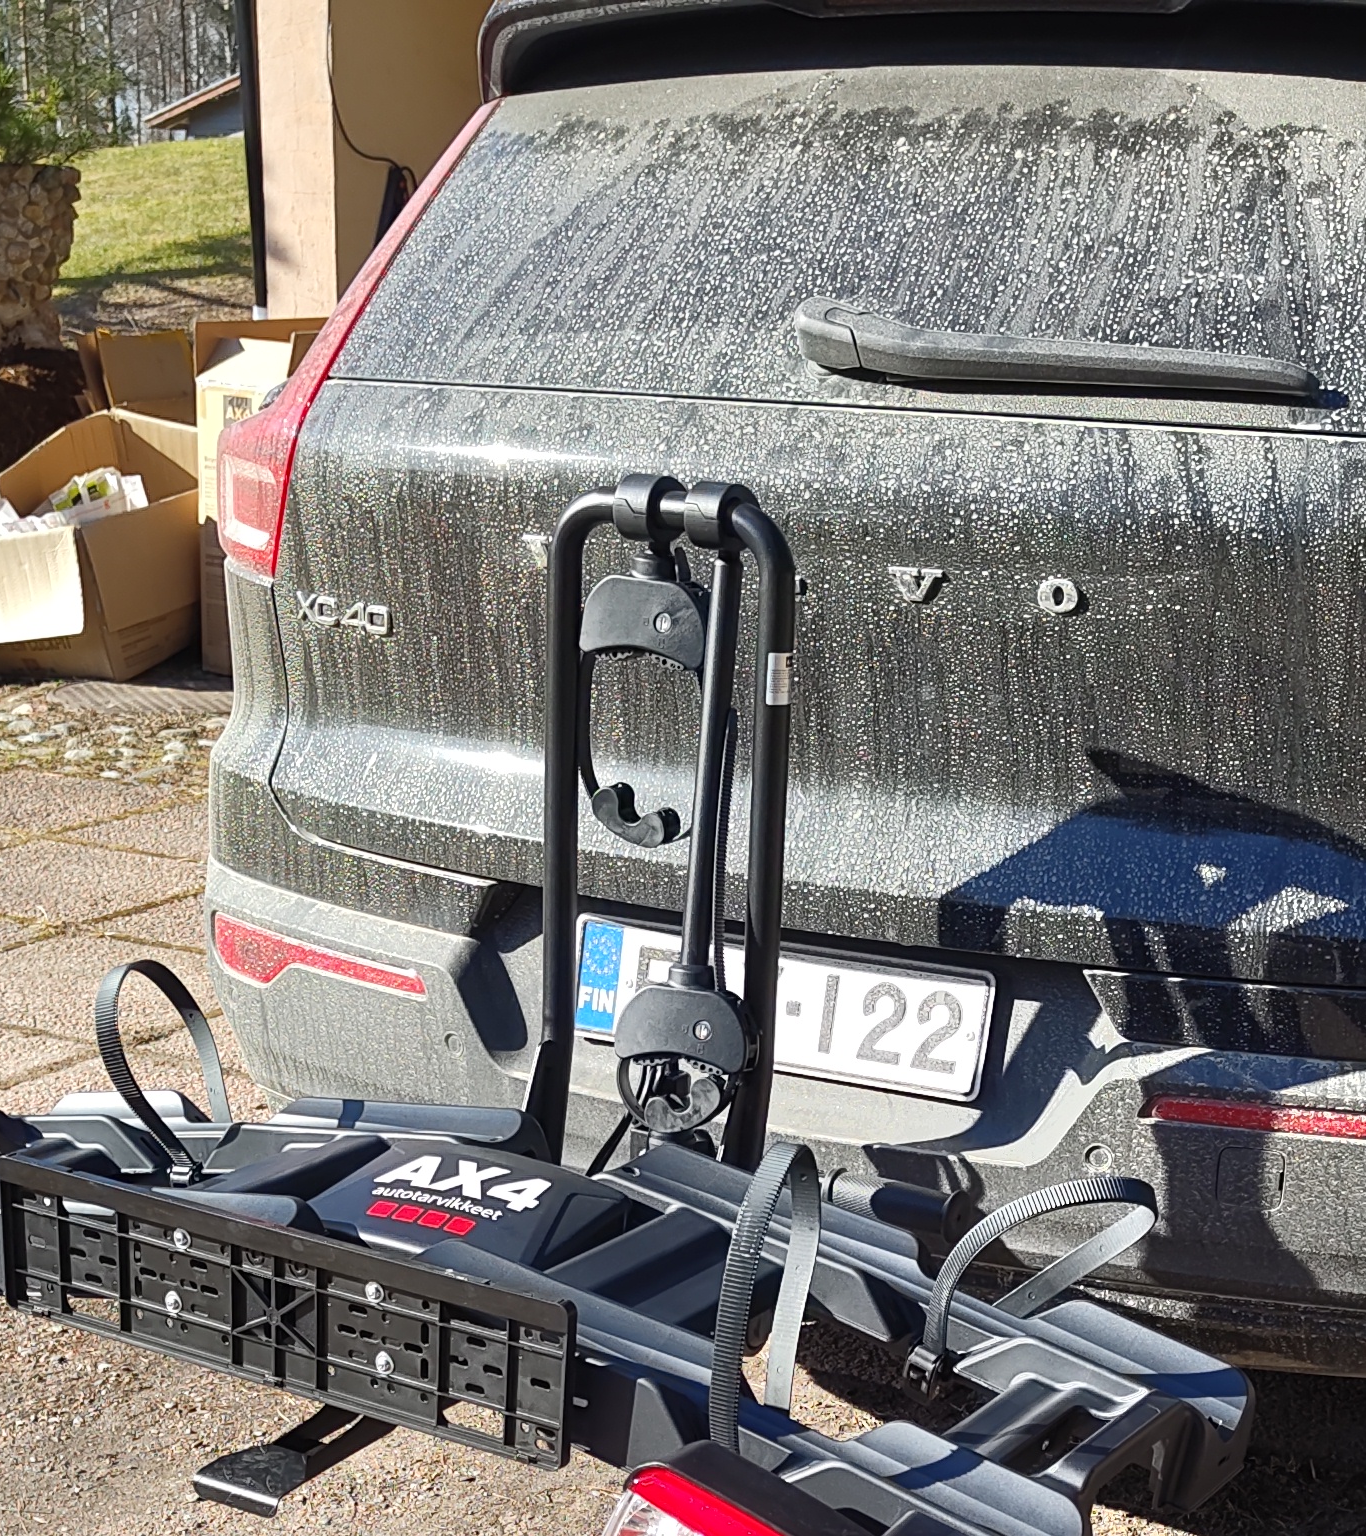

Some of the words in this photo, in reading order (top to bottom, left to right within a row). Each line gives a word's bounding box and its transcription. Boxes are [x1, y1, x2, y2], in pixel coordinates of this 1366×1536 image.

[296, 590, 391, 637] XC40
[577, 985, 615, 1014] FIN
[371, 1185, 504, 1222] autotarvikkeet
[373, 1155, 552, 1213] AX4
